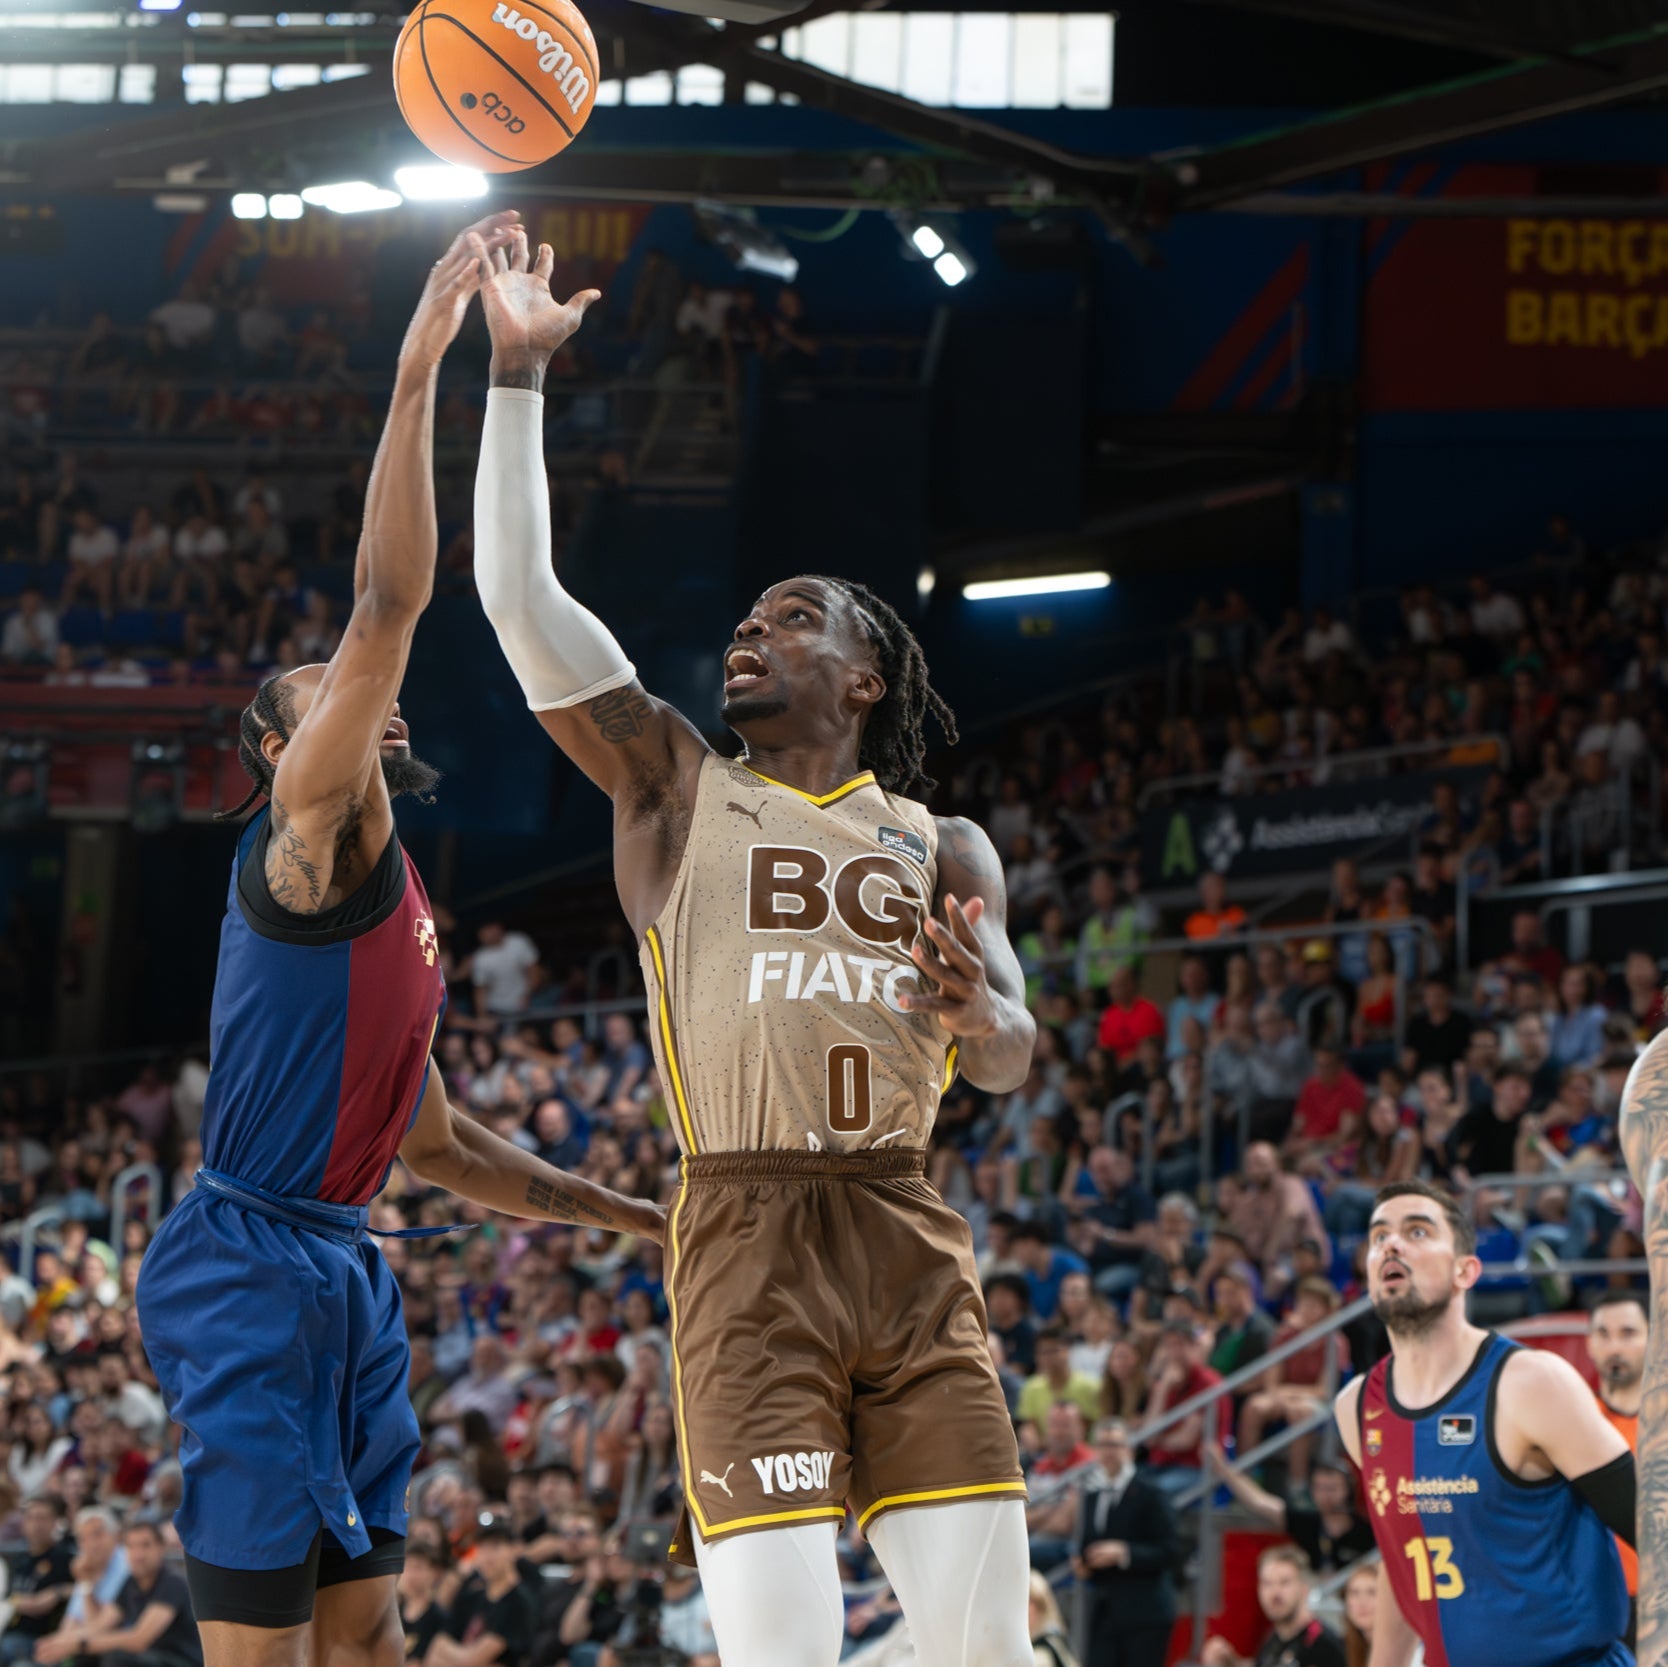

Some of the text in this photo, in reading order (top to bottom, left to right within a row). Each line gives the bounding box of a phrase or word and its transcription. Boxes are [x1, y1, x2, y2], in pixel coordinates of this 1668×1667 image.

[491, 2, 590, 115] Wilson
[481, 92, 526, 135] acb
[746, 844, 924, 957] BG
[826, 1043, 872, 1134] 0
[751, 1451, 835, 1495] YOSOY
[1396, 1475, 1480, 1496] Assistència
[1404, 1536, 1465, 1601] 13
